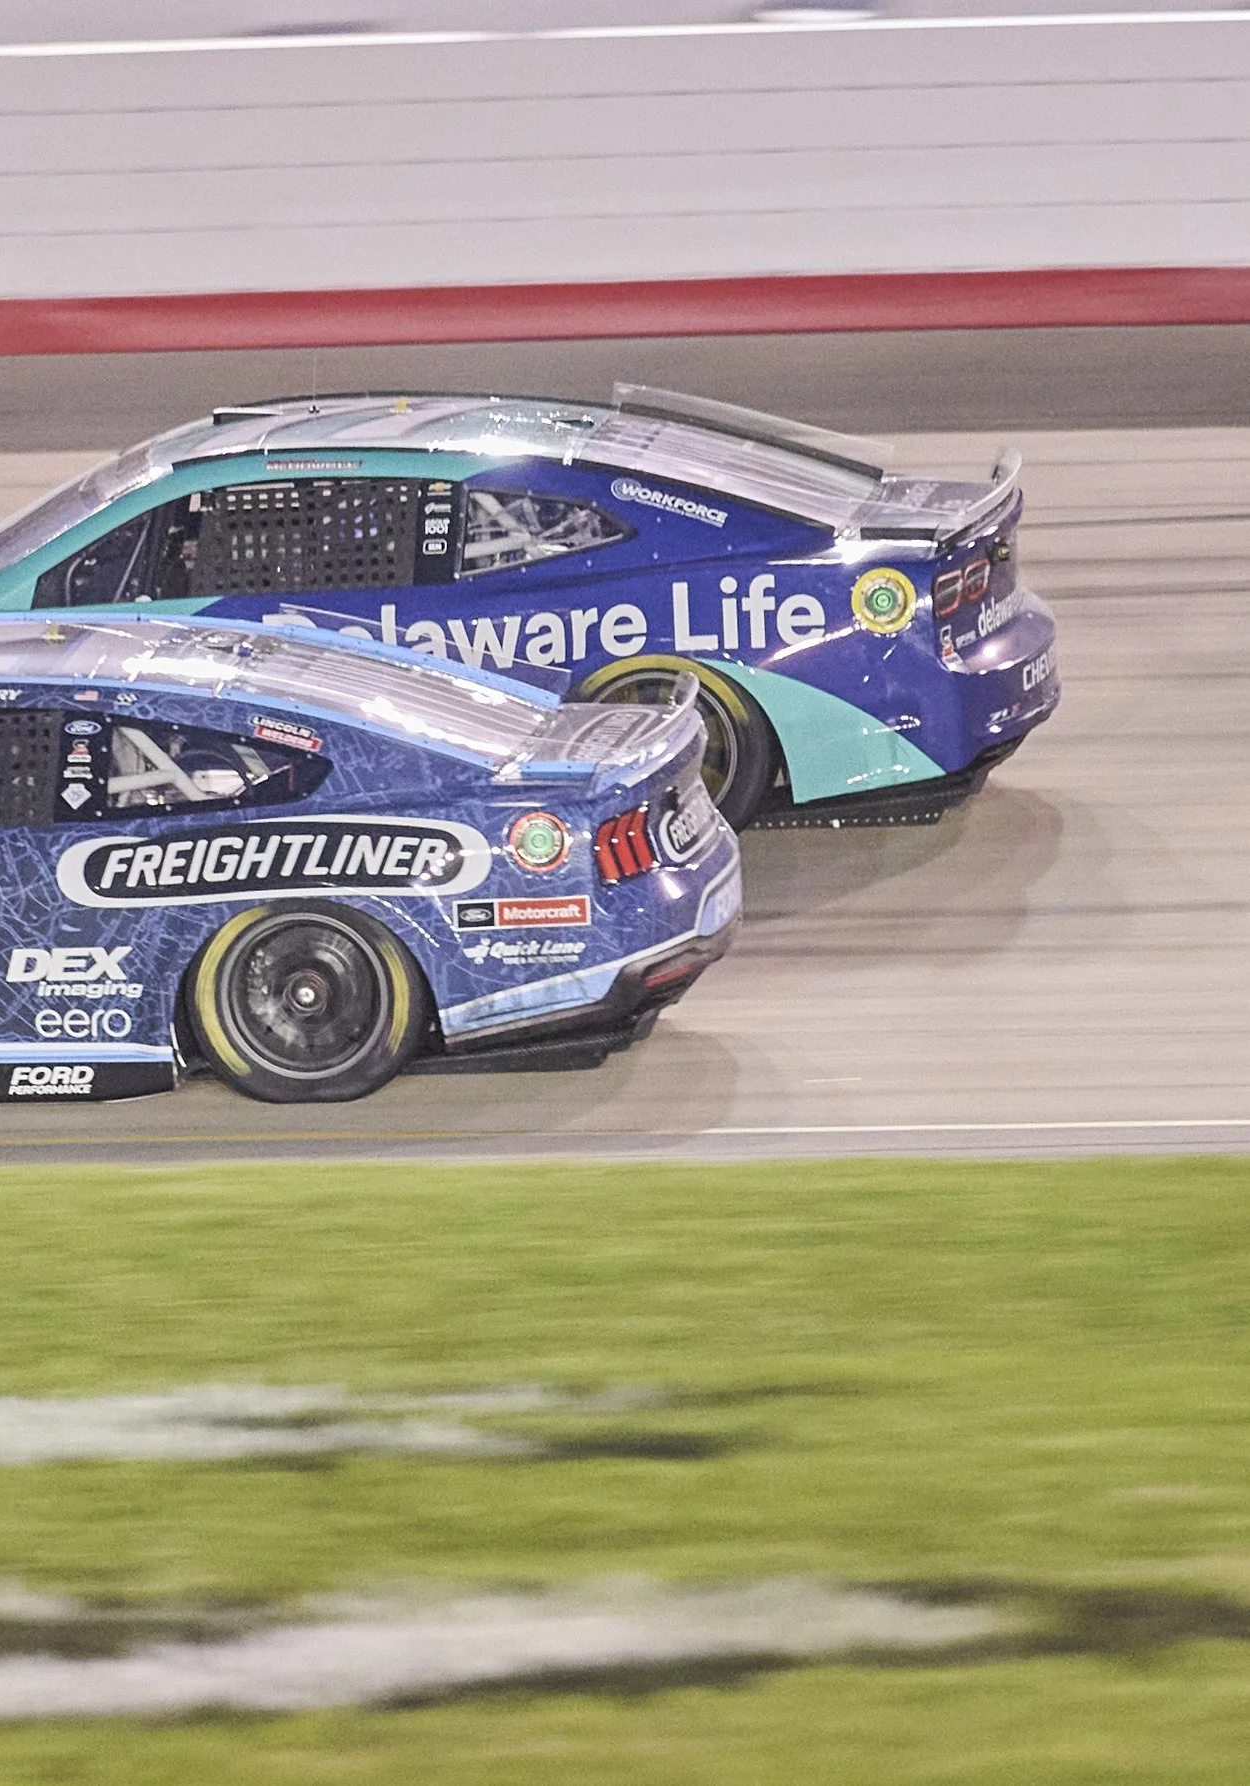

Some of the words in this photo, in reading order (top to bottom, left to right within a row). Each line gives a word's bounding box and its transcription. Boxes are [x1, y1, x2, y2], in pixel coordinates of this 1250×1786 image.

[622, 482, 728, 523] WORKFORCE
[263, 604, 646, 669] laware
[672, 574, 827, 651] Life
[252, 715, 312, 738] LINCOLN
[100, 833, 449, 889] FREIGHTLINER
[502, 903, 583, 920] Motorcraft
[490, 940, 541, 959] Quick
[540, 940, 586, 955] Lane
[6, 946, 133, 982] DEX
[37, 979, 144, 998] imaging
[34, 1008, 133, 1038] eero
[10, 1065, 95, 1086] FORD
[8, 1083, 93, 1096] PERFORMANCE
